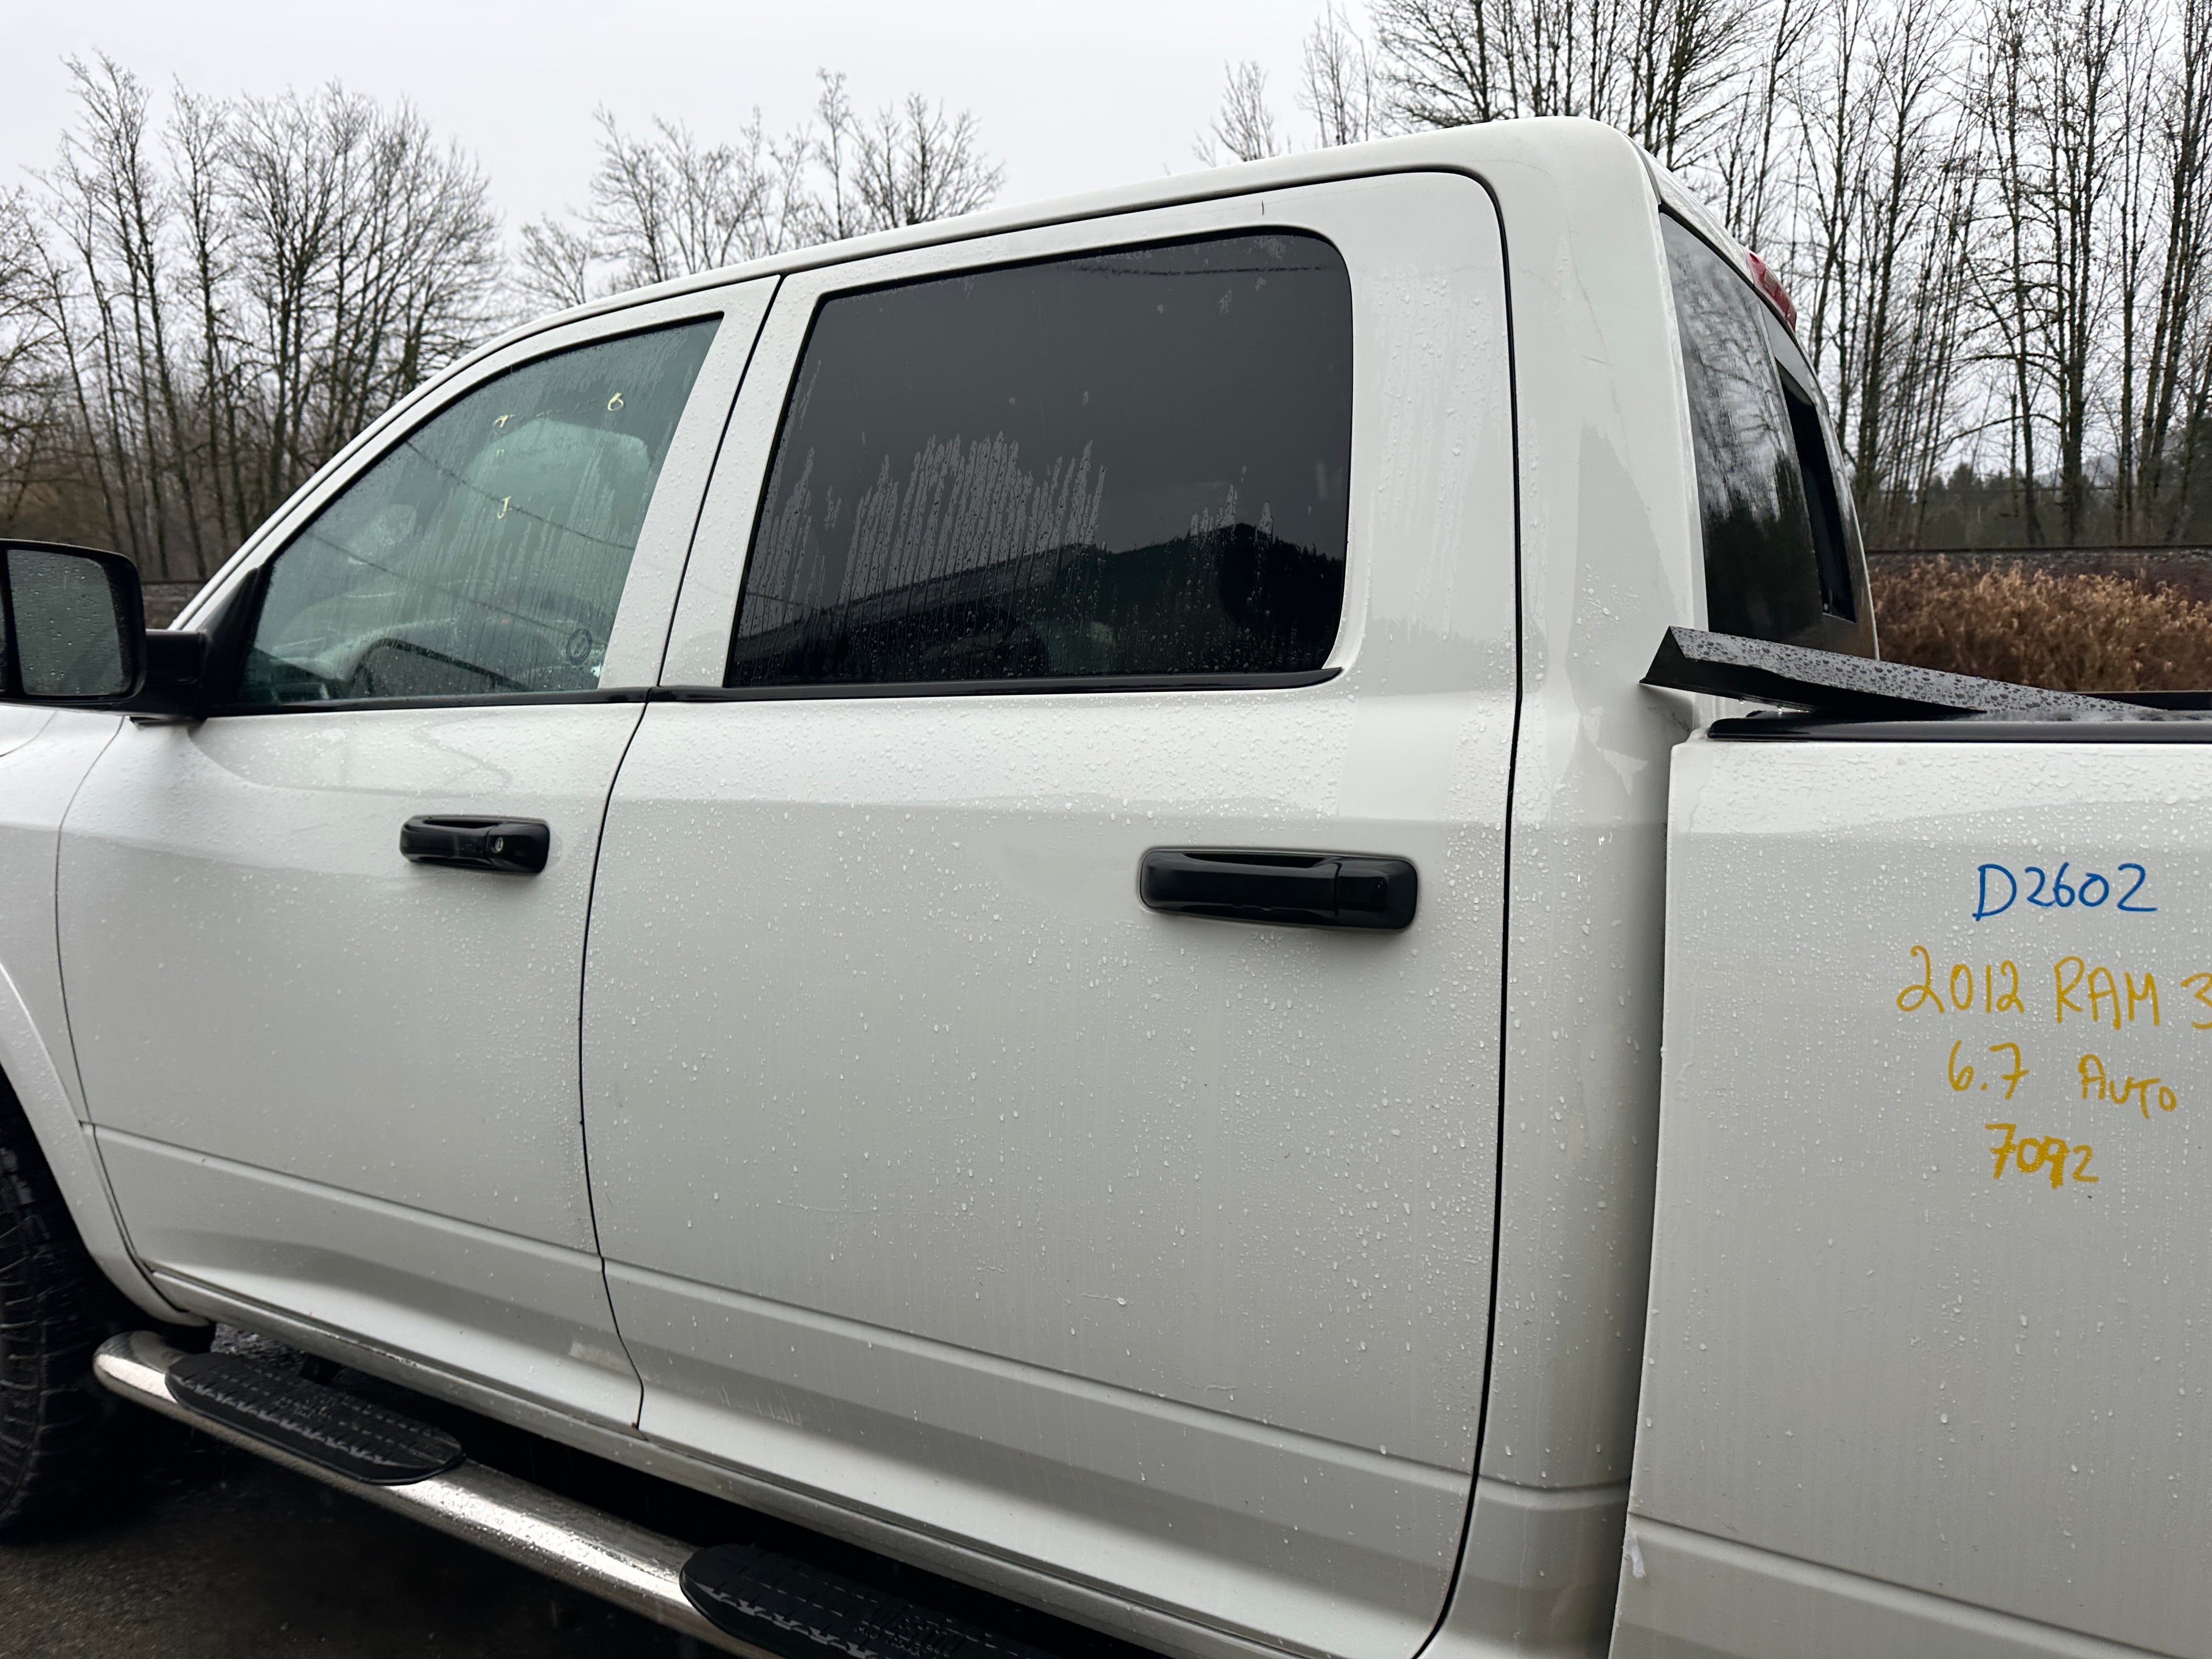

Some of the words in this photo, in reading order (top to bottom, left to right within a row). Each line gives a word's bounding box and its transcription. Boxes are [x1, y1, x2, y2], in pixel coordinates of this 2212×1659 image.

[1972, 862, 2157, 922] D2602
[1896, 945, 2025, 1014] 2012
[2054, 956, 2160, 1031] RAM
[1948, 1040, 2029, 1100] 6.7
[1985, 1123, 2099, 1190] 7092
